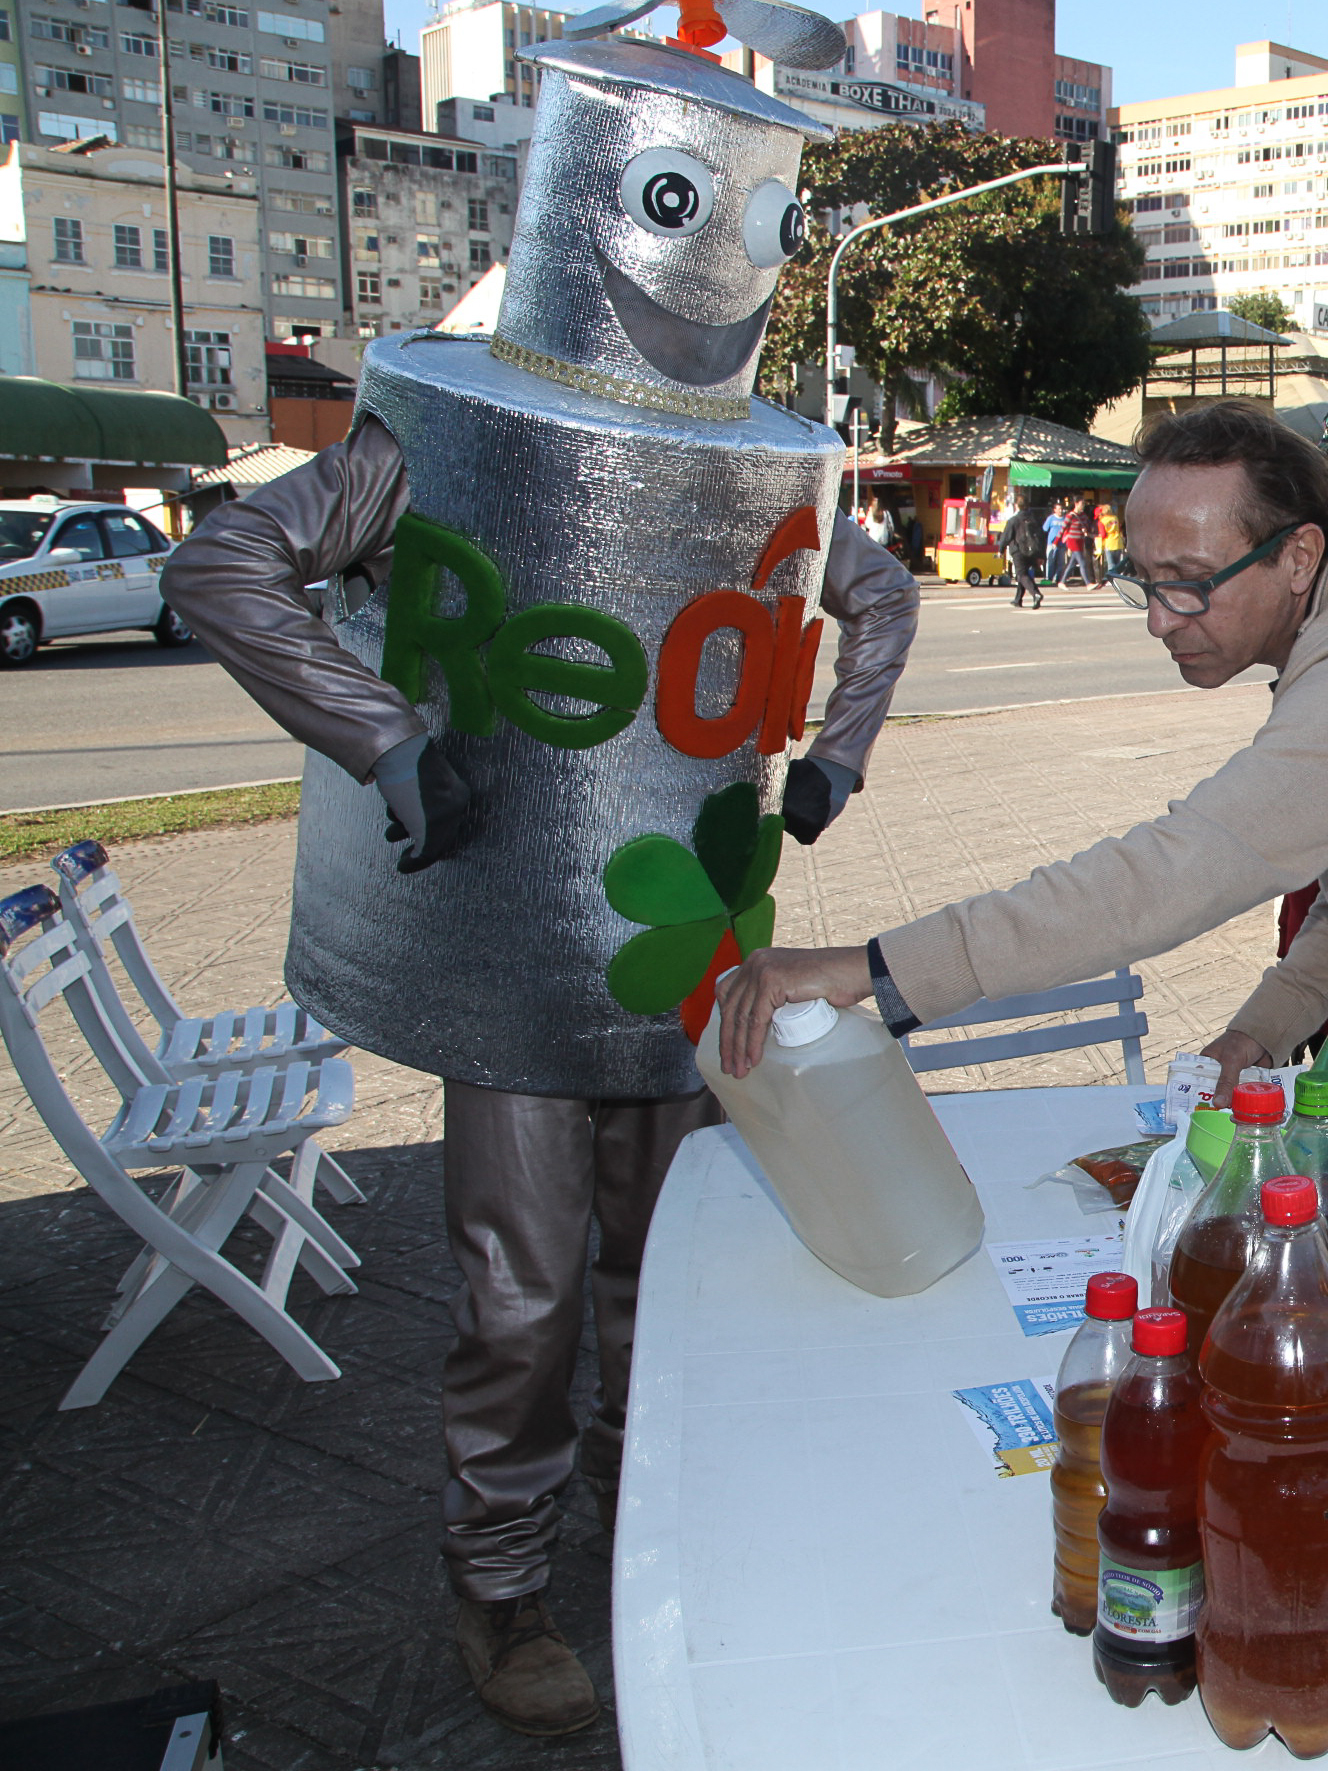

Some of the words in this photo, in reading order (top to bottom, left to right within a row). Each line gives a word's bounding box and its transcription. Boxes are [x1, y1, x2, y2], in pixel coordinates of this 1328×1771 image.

[785, 75, 828, 92] ACADEMIA
[839, 84, 883, 106] BOXE
[887, 90, 928, 113] THAI
[872, 469, 903, 478] VPmoto
[1006, 1255, 1026, 1263] 100
[991, 1387, 1027, 1426] TRILHÕES
[1014, 1426, 1039, 1443] 330
[1036, 1459, 1050, 1468] 20
[1131, 1577, 1141, 1585] DE
[1141, 1580, 1161, 1596] SÓDIO
[1103, 1600, 1157, 1627] FLORESTA
